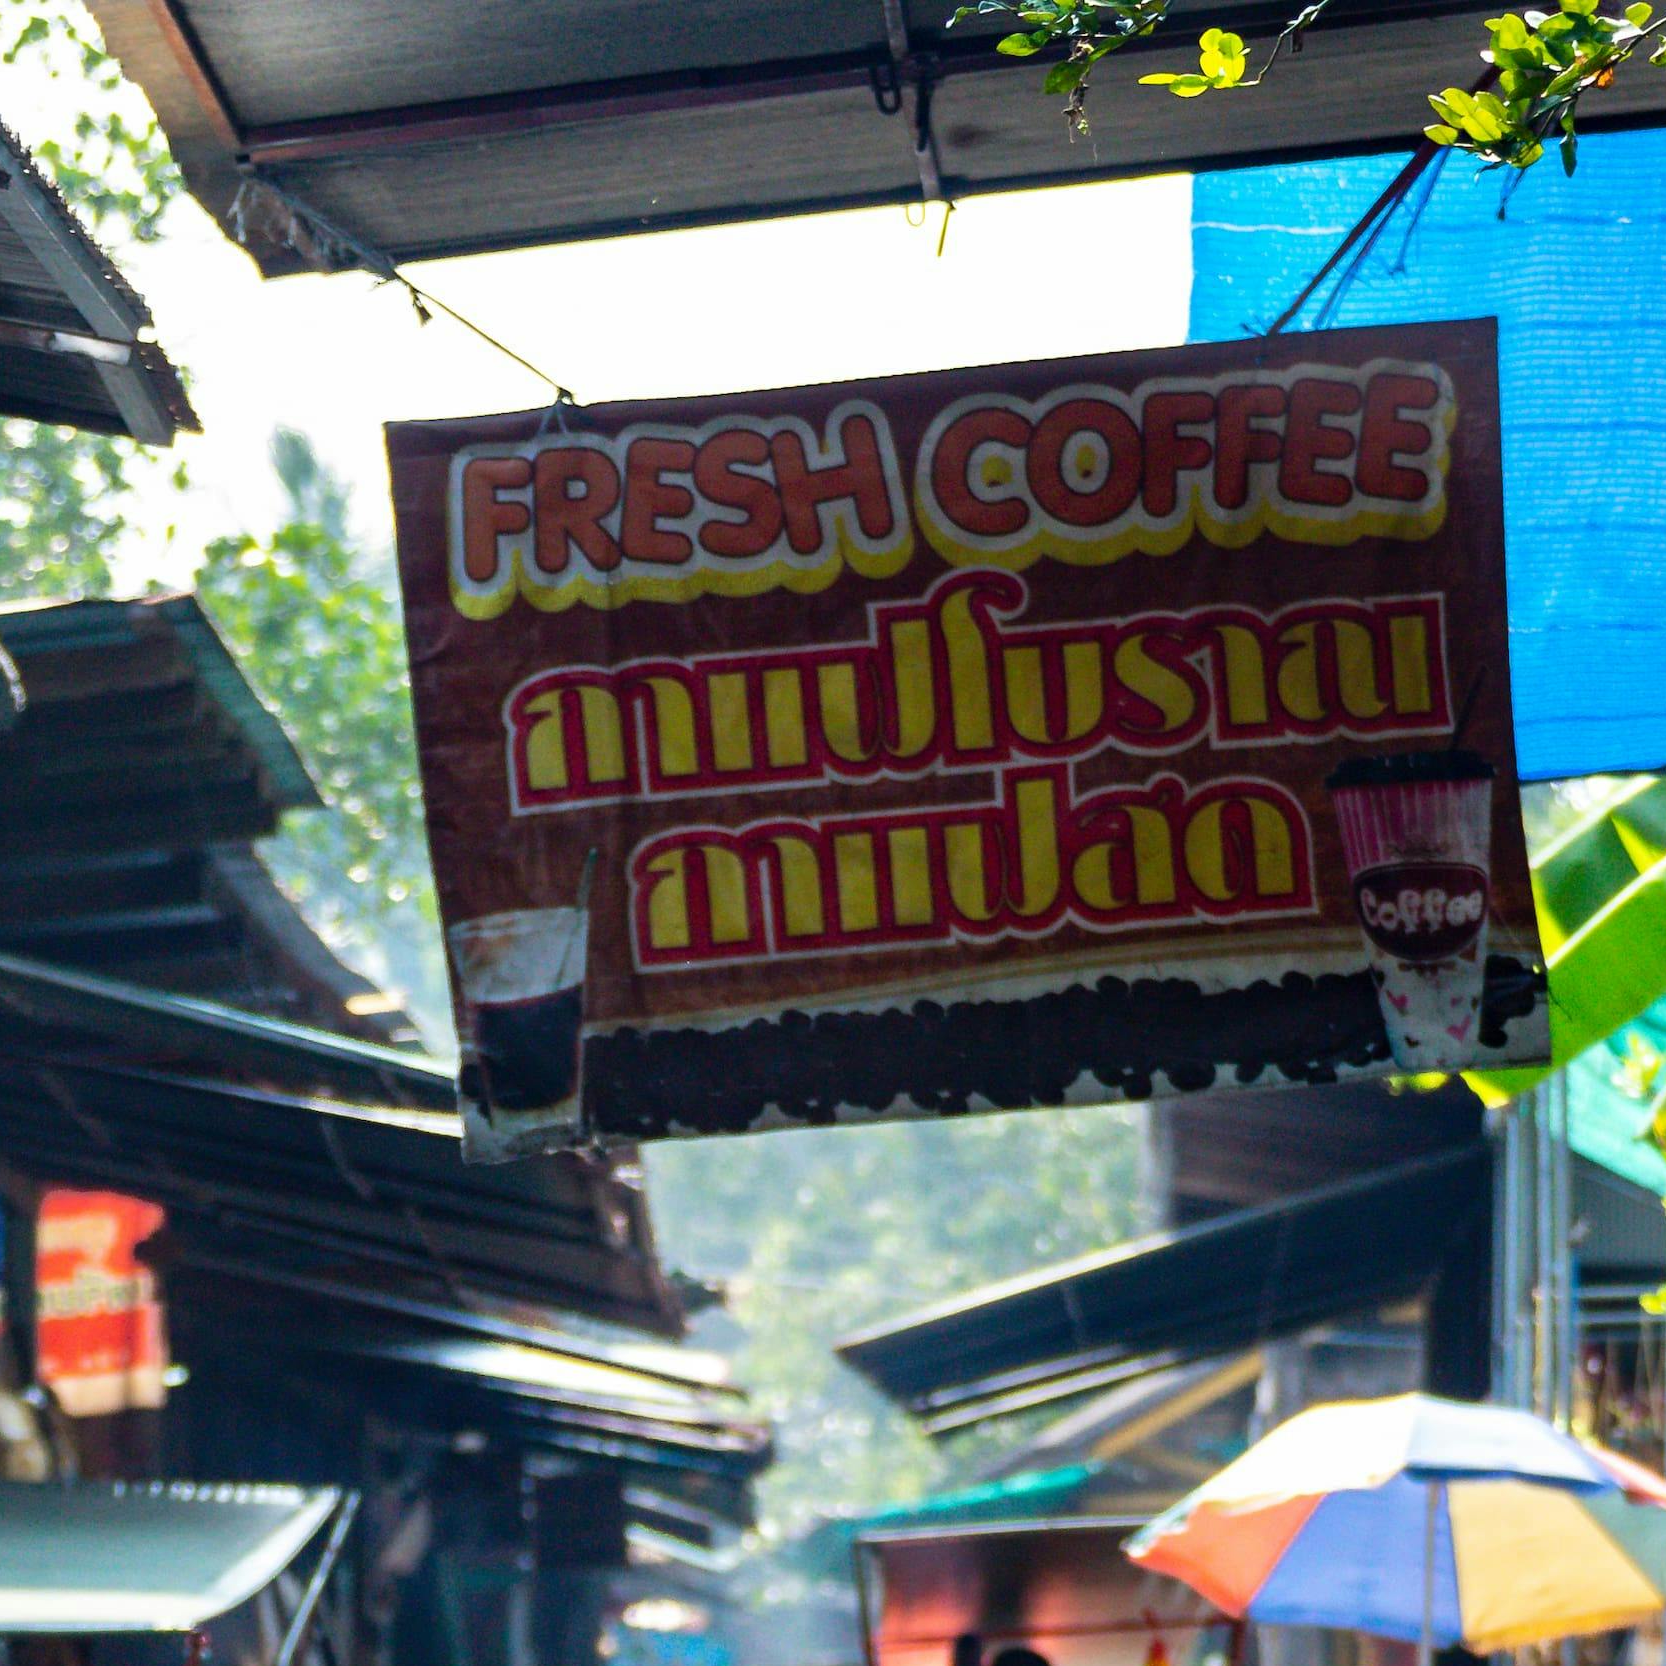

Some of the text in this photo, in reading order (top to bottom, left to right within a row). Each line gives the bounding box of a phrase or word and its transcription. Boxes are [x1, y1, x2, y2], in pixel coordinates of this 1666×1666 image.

[460, 371, 1440, 584] FRESH COFFEE
[516, 578, 1439, 791] กาแฟโบราณ
[637, 764, 1303, 956] กาแฟสด
[1359, 886, 1484, 934] Coffee
